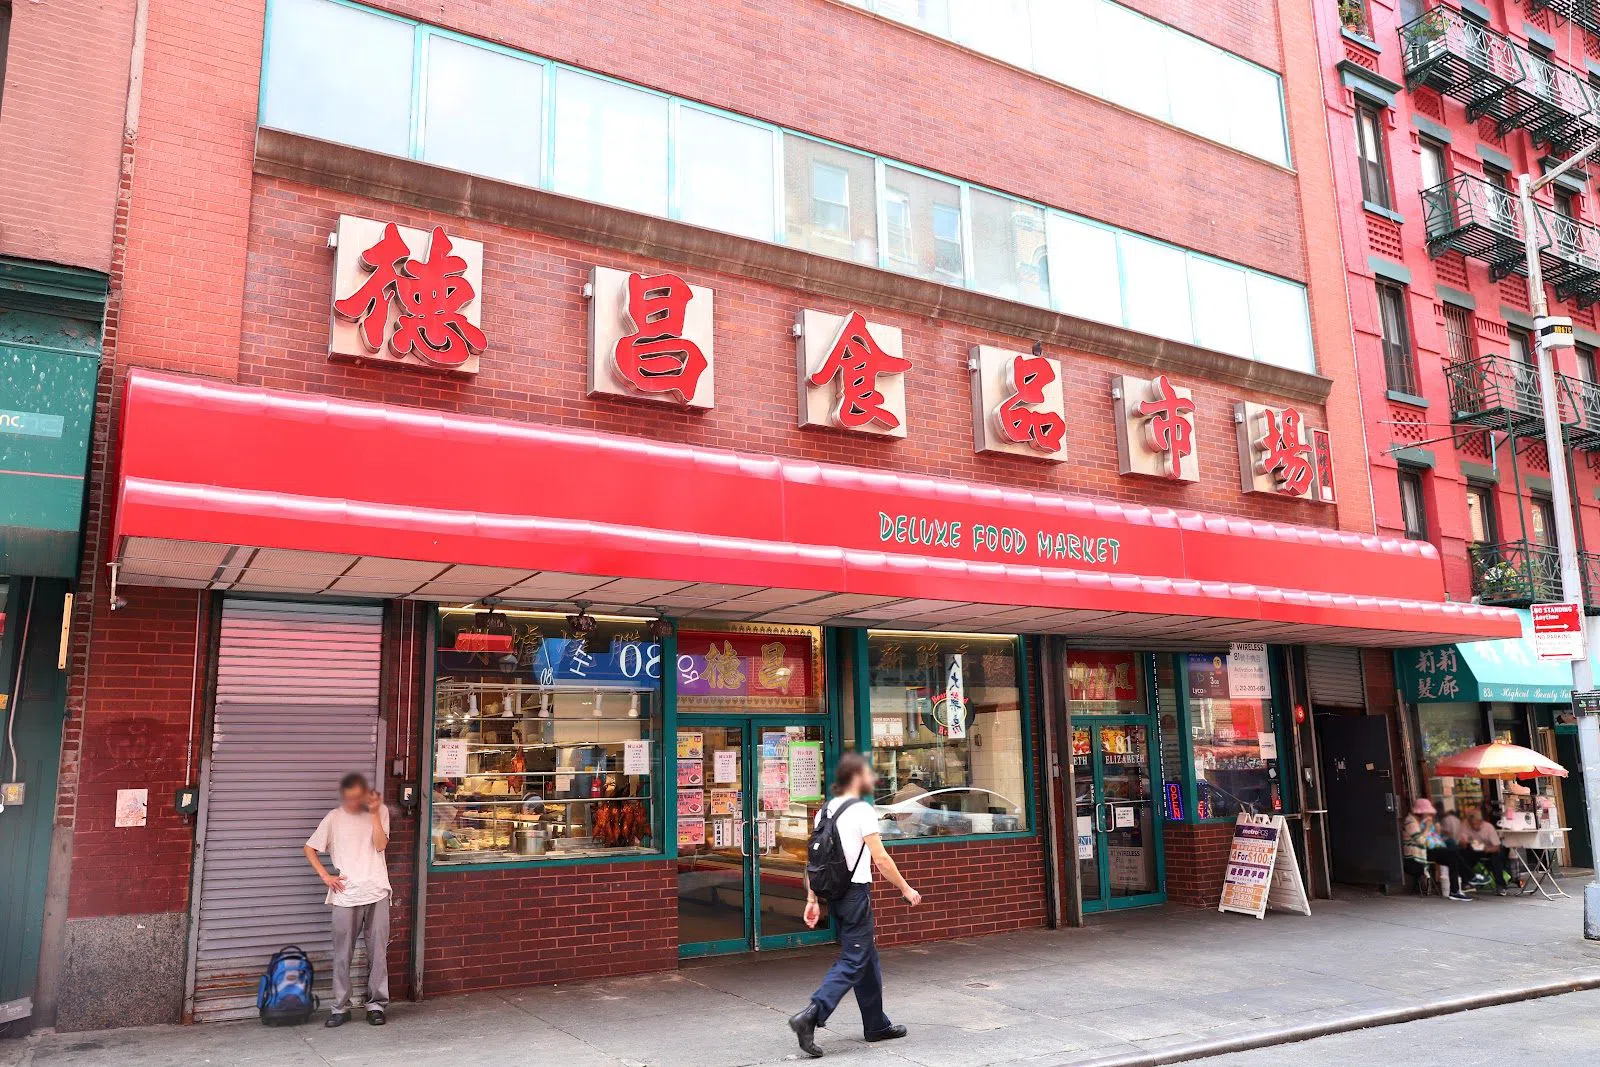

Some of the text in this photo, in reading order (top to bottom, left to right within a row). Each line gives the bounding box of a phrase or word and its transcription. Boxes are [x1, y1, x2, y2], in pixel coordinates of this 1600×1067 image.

[879, 511, 1121, 566] DELUXE FOOD MARKET
[1236, 643, 1264, 652] WIRELESS
[1416, 647, 1457, 674] 莉莉
[1417, 674, 1460, 699] 髮廊
[1115, 734, 1134, 754] 81
[1073, 756, 1088, 766] ETH
[1105, 755, 1145, 765] ELIZABETH
[1169, 785, 1182, 819] OPEN
